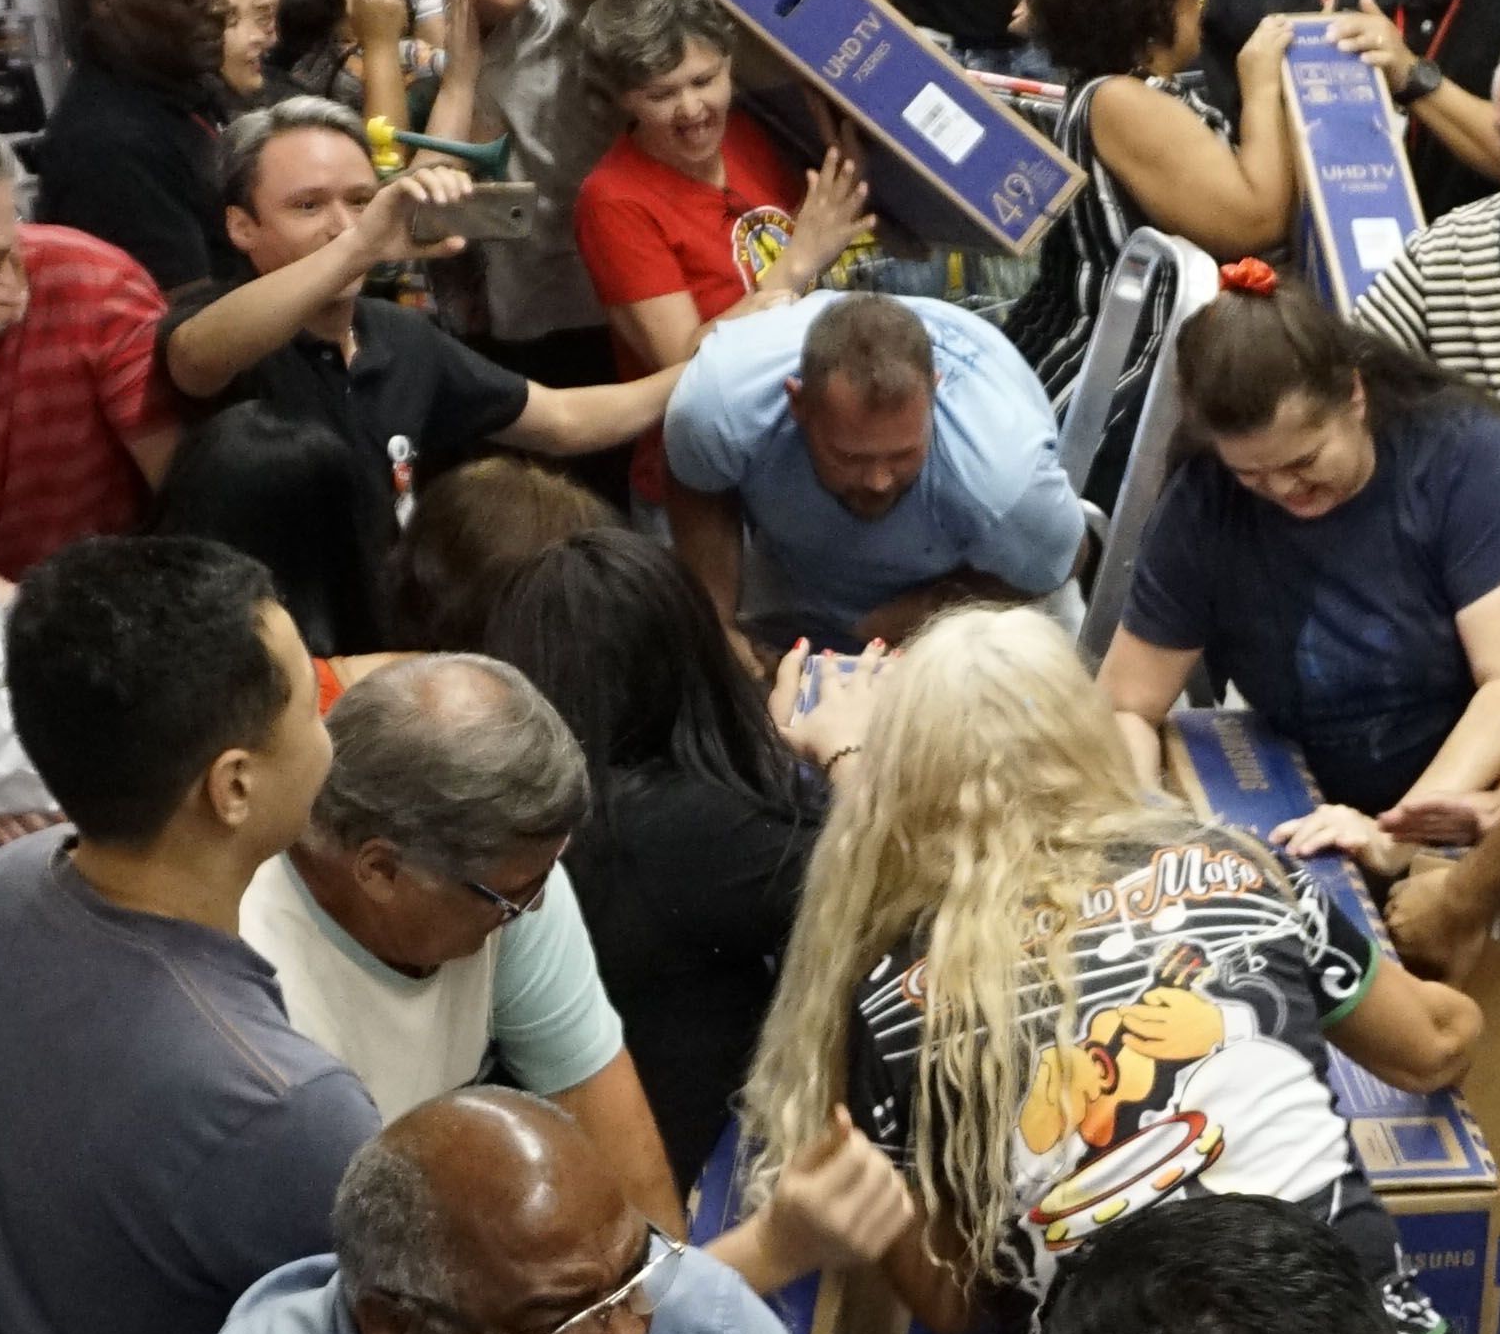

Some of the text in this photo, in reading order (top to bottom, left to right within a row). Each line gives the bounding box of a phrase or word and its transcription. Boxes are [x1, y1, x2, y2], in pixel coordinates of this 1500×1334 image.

[821, 9, 884, 80] UHD TV
[1321, 162, 1396, 183] UHD TV
[1403, 1249, 1476, 1268] SUNG
